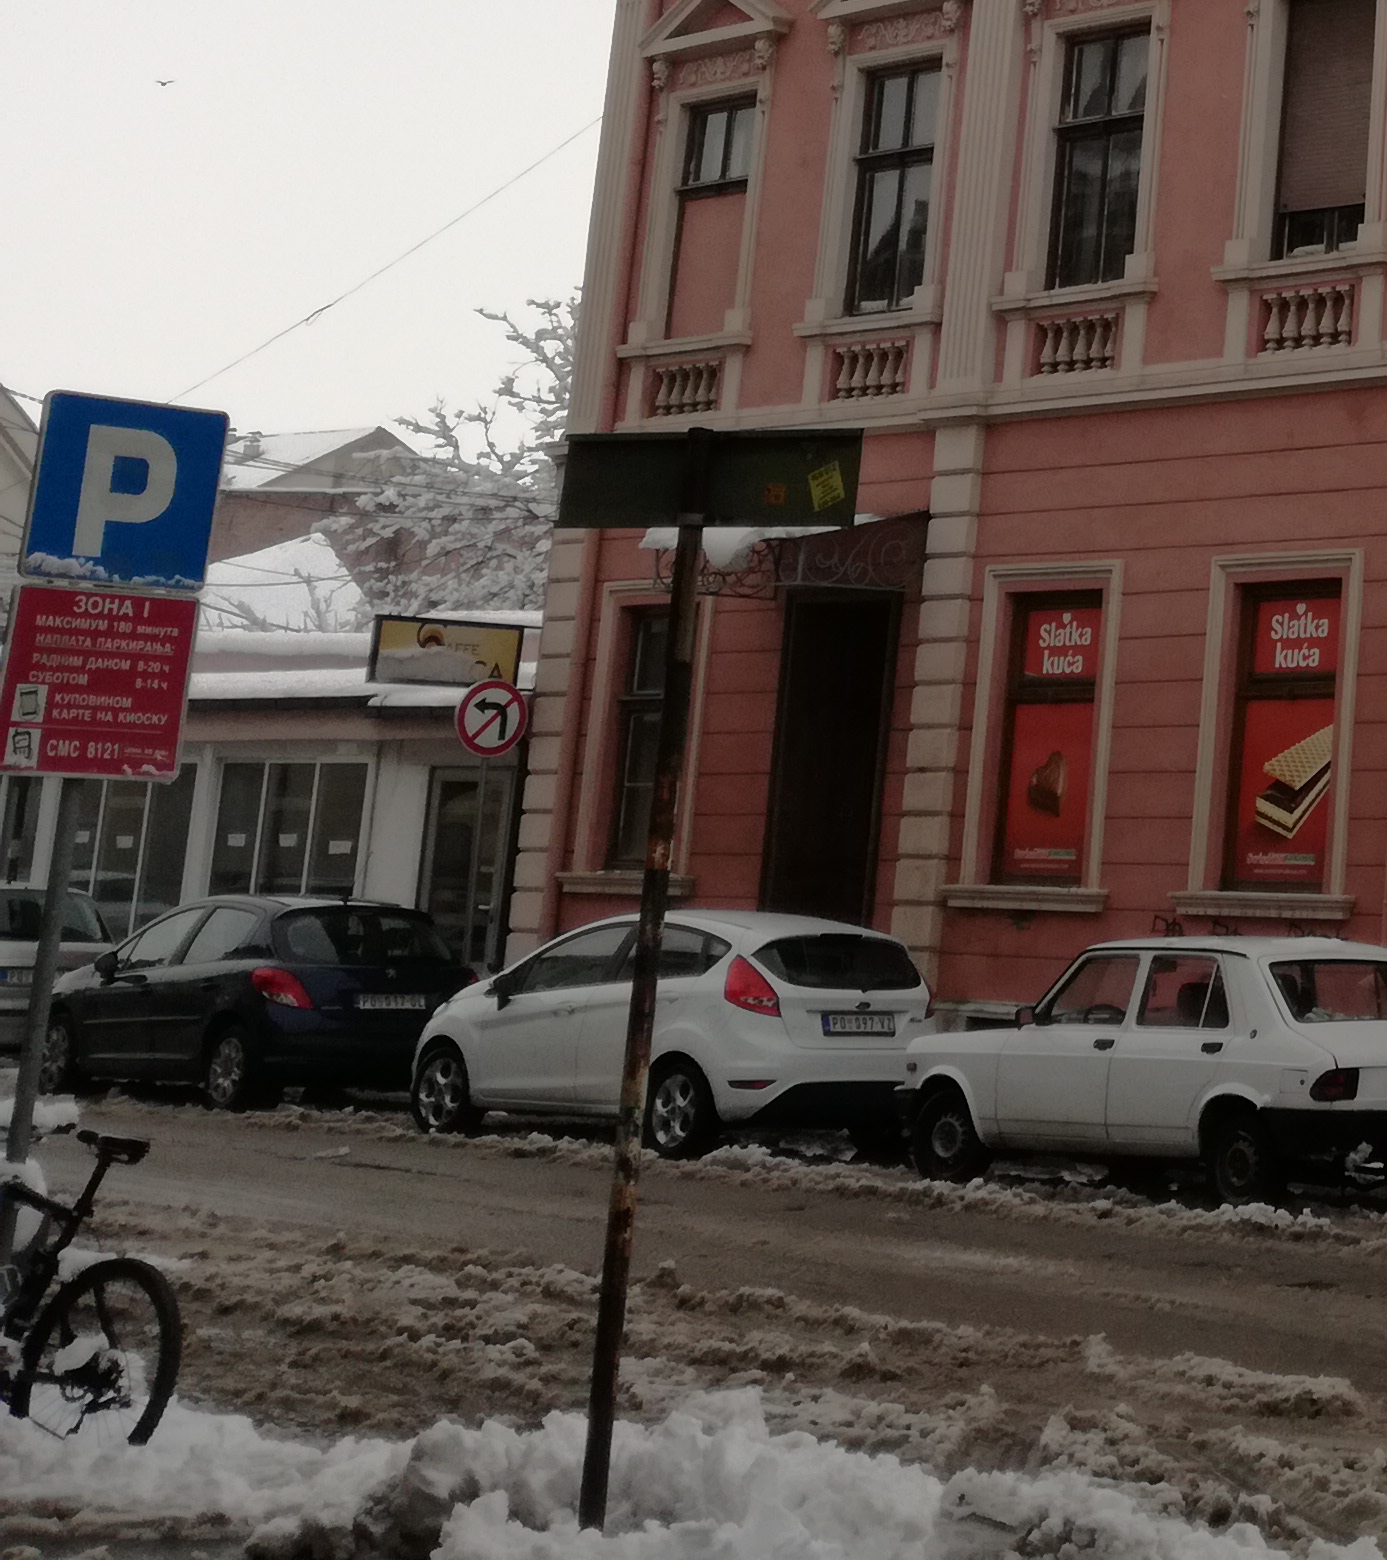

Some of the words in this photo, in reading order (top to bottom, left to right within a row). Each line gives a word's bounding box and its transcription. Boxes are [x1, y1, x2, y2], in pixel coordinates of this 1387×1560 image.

[72, 424, 177, 557] P
[73, 595, 133, 617] ЗОНА
[35, 615, 108, 631] МАКСИМУМ
[113, 621, 132, 633] 180
[137, 625, 179, 638] минута
[1039, 621, 1092, 647] Slatka
[1271, 612, 1328, 639] Slatka
[35, 633, 92, 649] НАПЛАТА
[32, 653, 83, 668] РАДНИМ
[86, 657, 131, 670] ДАНОМ
[1043, 650, 1083, 674] kuća
[1275, 642, 1319, 668] kuća
[29, 671, 88, 685] СУБОТОМ
[54, 693, 132, 708] КУПОВИНОМ
[52, 709, 92, 721] КАРТЕ
[96, 711, 113, 722] НА
[118, 712, 168, 725] КИОСКУ
[87, 742, 120, 759] 8121
[832, 1016, 846, 1029] PO
